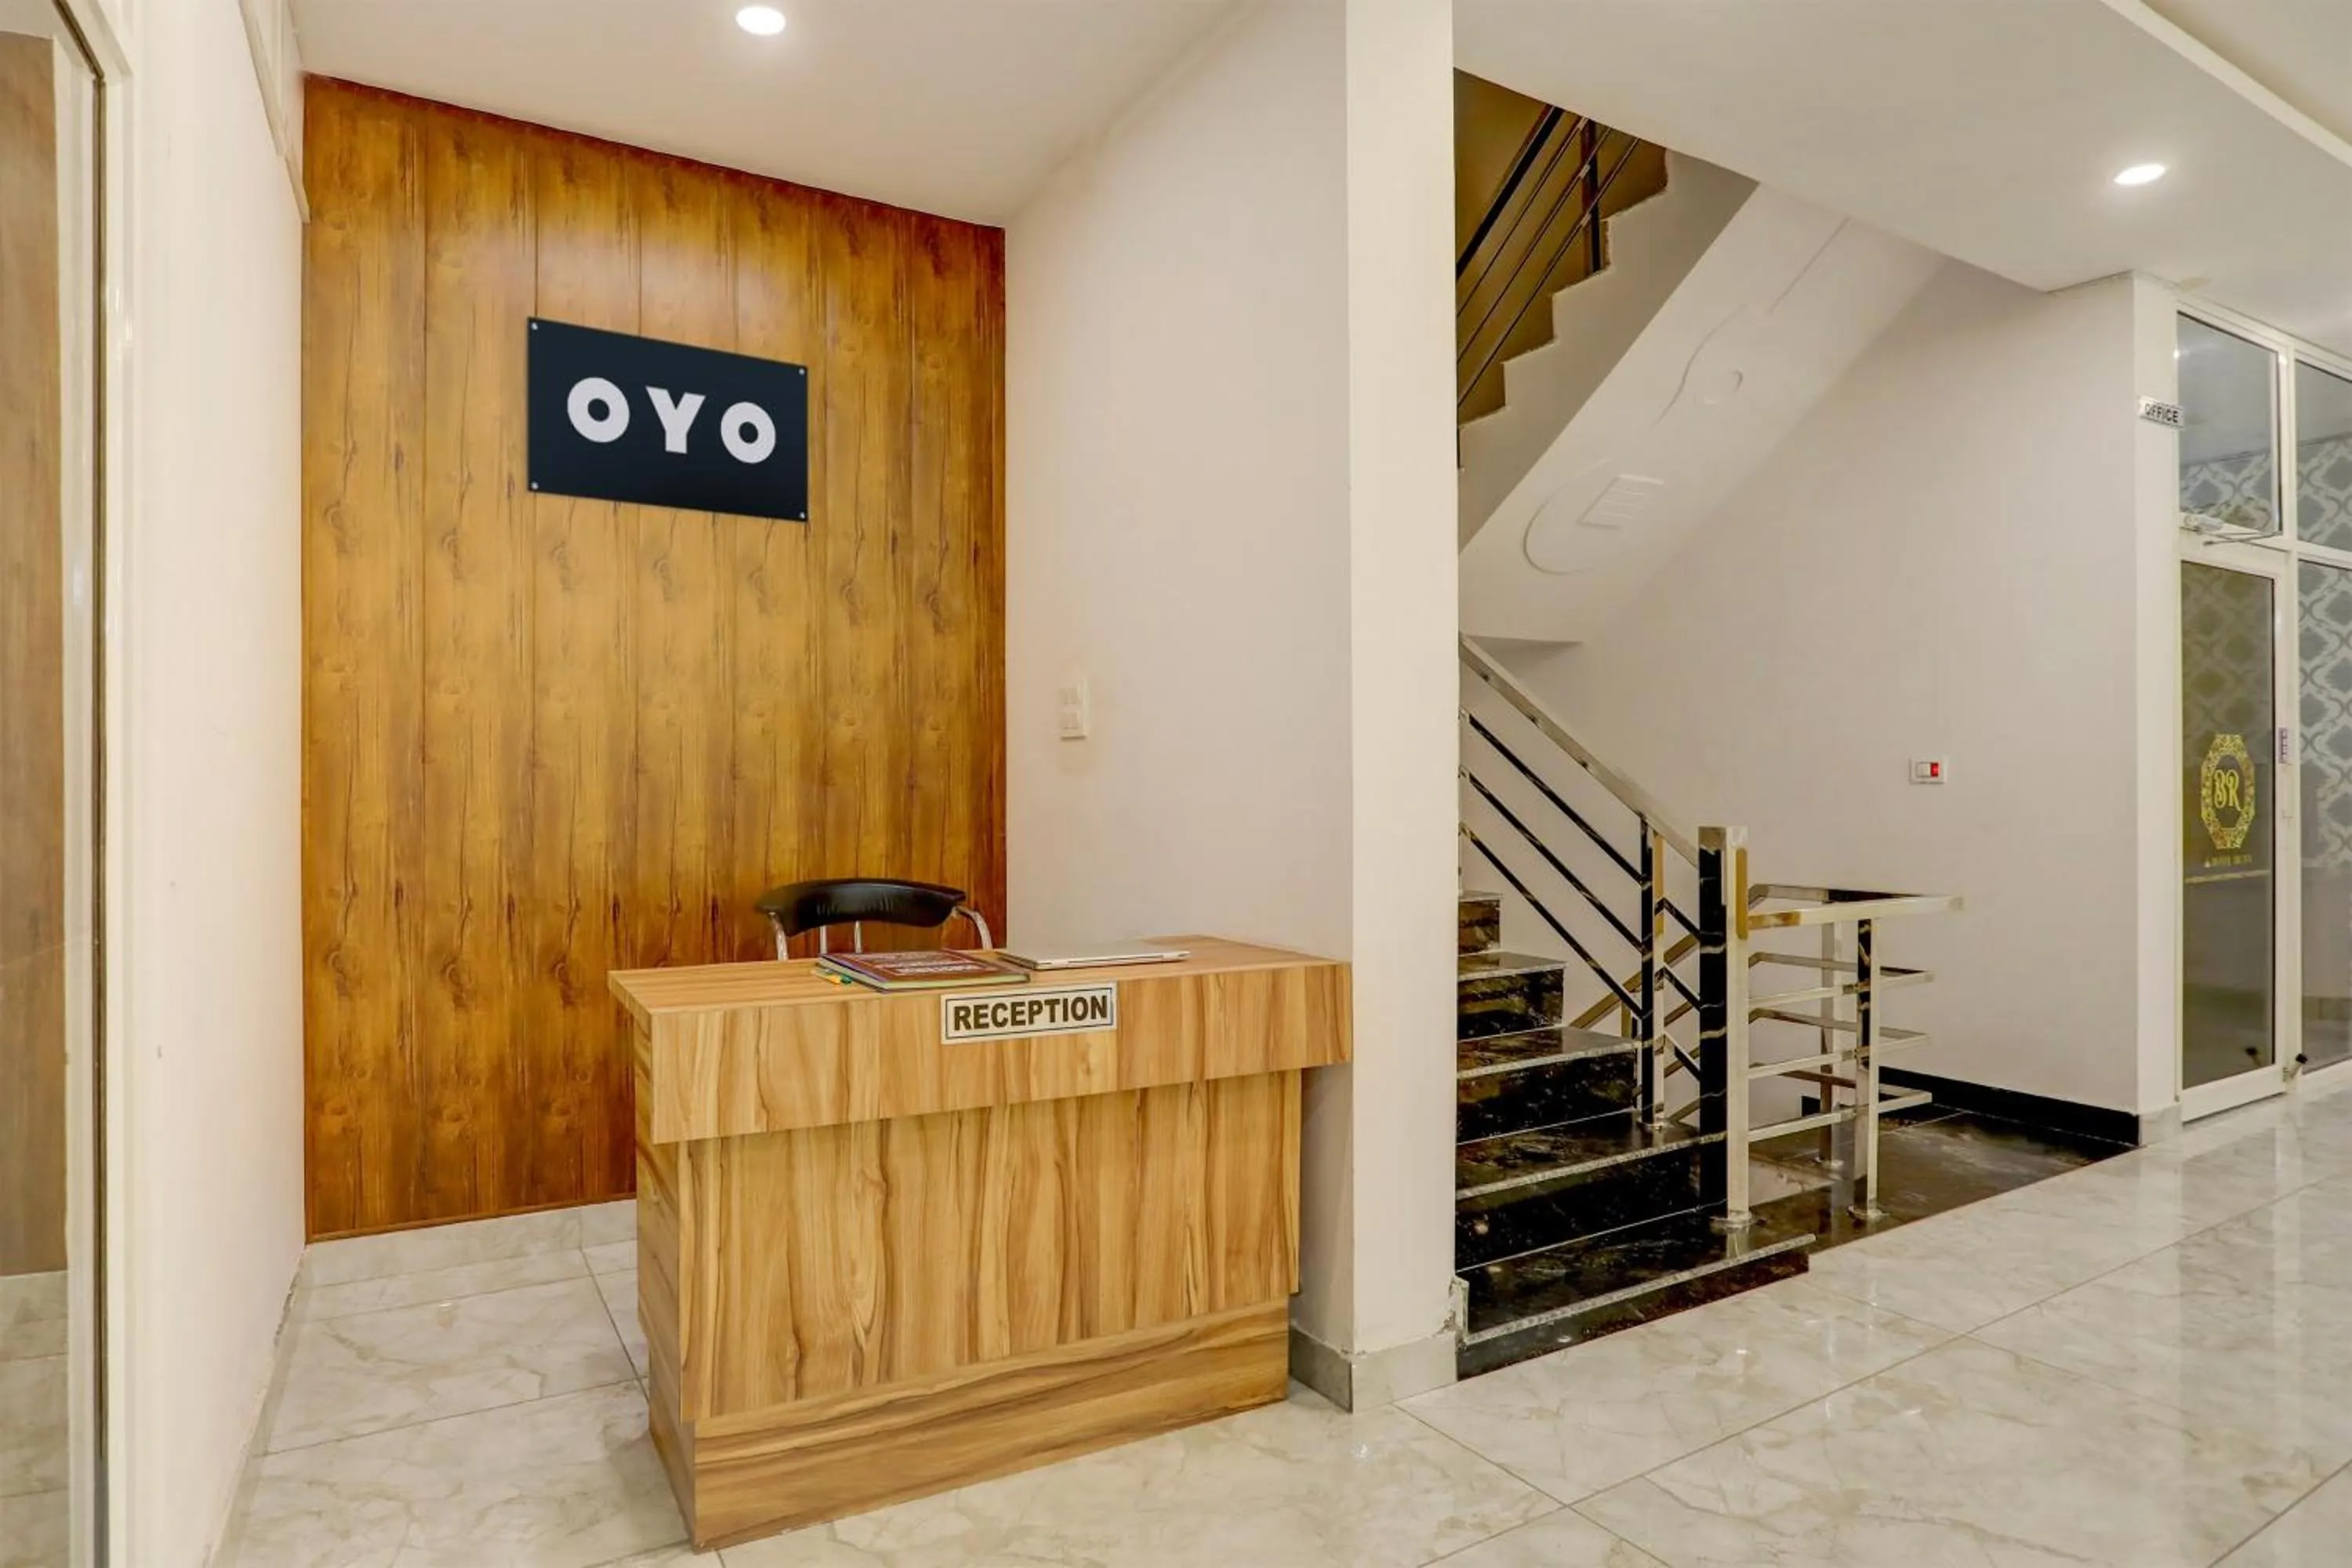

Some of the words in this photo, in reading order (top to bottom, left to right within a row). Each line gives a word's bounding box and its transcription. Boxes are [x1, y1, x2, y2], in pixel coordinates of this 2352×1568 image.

[567, 377, 776, 464] OYO
[2144, 403, 2179, 423] OFFICE
[953, 994, 1108, 1032] RECEPTION
